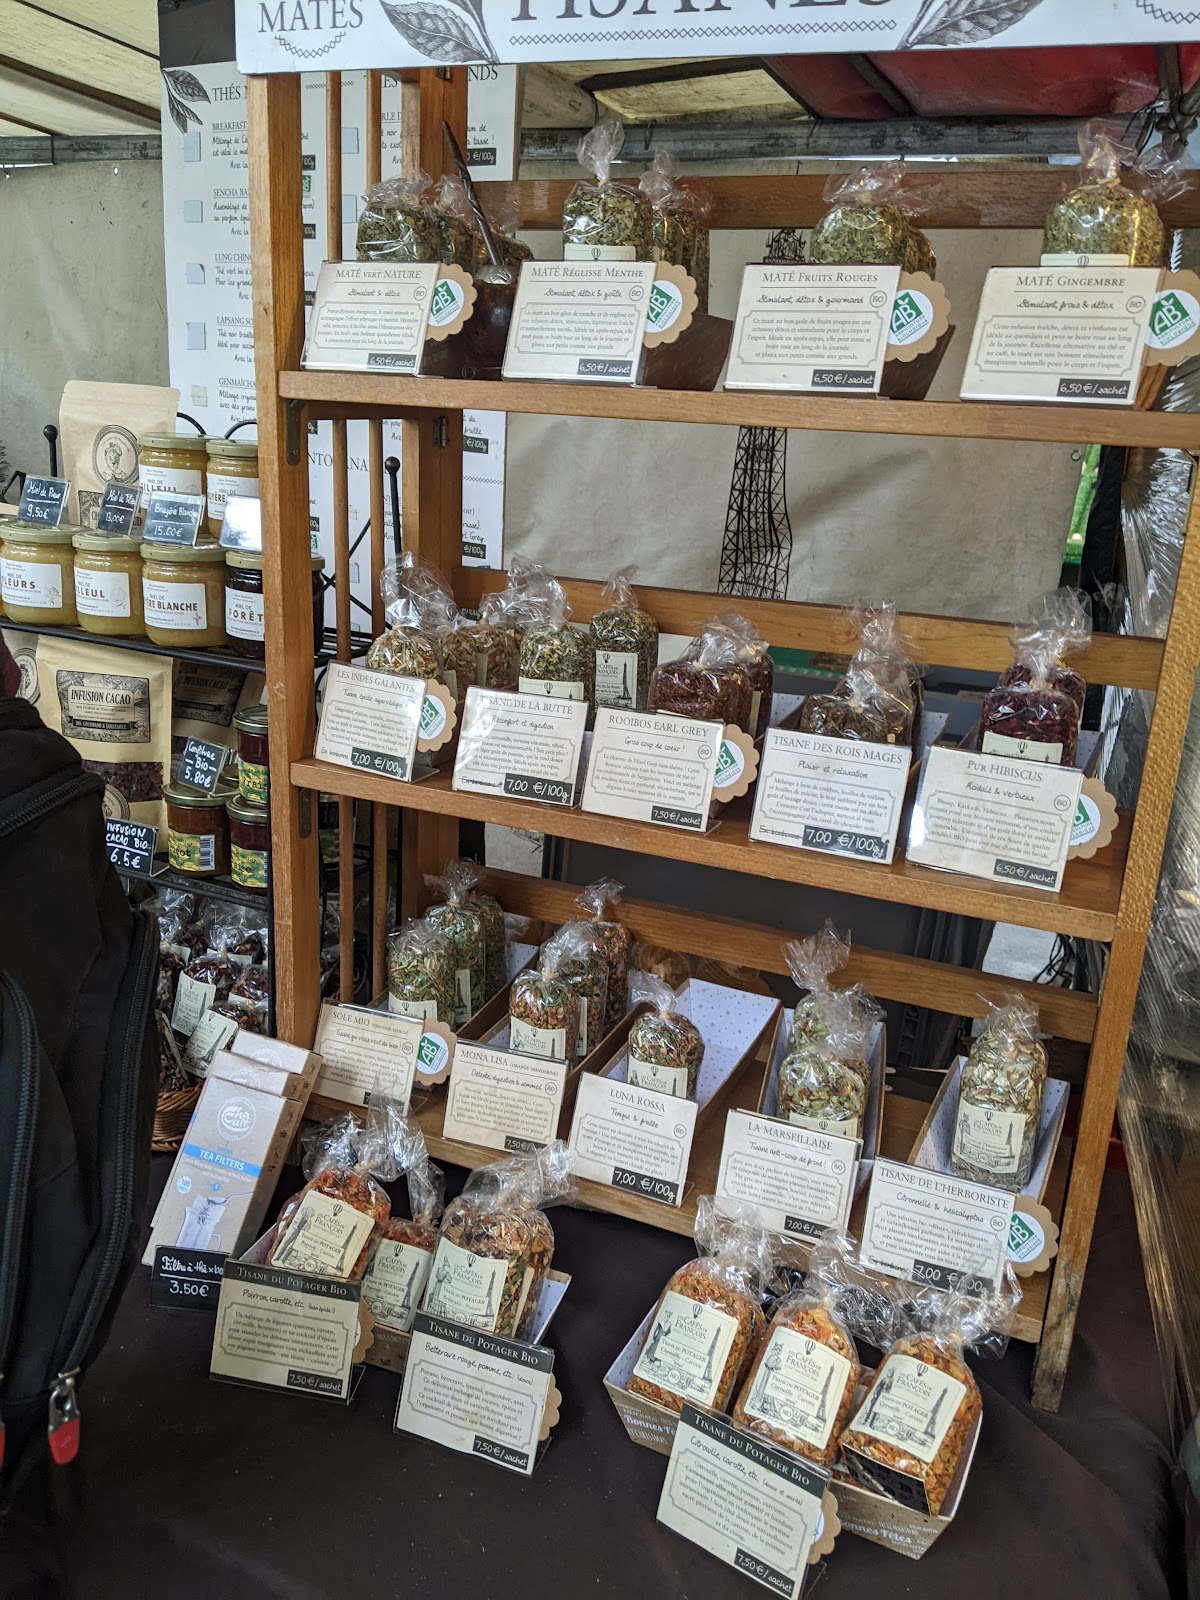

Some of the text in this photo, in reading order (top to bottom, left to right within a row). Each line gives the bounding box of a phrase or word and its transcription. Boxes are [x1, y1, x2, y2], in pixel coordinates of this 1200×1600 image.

[212, 83, 241, 101] THÉS
[212, 121, 247, 131] BREAKFAST
[215, 253, 232, 261] LUNG
[336, 268, 361, 278] MATÉ
[384, 270, 421, 279] NATURE
[531, 266, 643, 278] MATÉ RÉGLISSE MENTHE
[762, 270, 878, 282] MATÉ FRUITS ROUGES
[1016, 274, 1126, 287] MATÉ GINGEMBRE
[826, 296, 864, 307] gourmand
[217, 316, 245, 325] LAPSANG
[891, 303, 917, 331] AB
[1154, 305, 1183, 334] AB
[27, 504, 49, 519] 9.50€
[155, 525, 183, 537] 15.00€
[157, 603, 197, 611] BLANCHE
[337, 670, 415, 692] LES INDES GALANTES
[71, 689, 131, 705] INFUSION CACAO
[513, 700, 573, 715] DE LA BUTTE
[529, 721, 554, 731] digestion
[609, 714, 709, 737] ROOIBOS EARL GREY
[773, 735, 902, 764] TISANE DES ROIS MAGES
[352, 752, 370, 765] 7,00
[185, 766, 211, 788] 5.80€
[833, 768, 868, 779] relaxation
[967, 760, 1043, 782] PUR HIBISCUS
[506, 779, 528, 792] 7,00
[106, 833, 128, 845] CACAO
[806, 829, 832, 844] 7,00
[111, 848, 140, 868] 6.5€
[333, 1012, 370, 1026] SOLE MIO
[461, 1049, 508, 1066] MONA LISA
[610, 1088, 666, 1112] LUNA ROSSA
[748, 1122, 833, 1151] LA MARSEILLAISE
[200, 1149, 214, 1161] TEA
[215, 1155, 245, 1171] FILTERS
[615, 1171, 636, 1186] 7,00
[880, 1167, 1009, 1209] TISANE DE L'HERBORISTE
[170, 1280, 209, 1297] 3.50€
[237, 1267, 347, 1295] TISANE DU POTAGER BIO
[675, 1319, 706, 1339] FRANÇOIS
[429, 1321, 538, 1365] TISANE DU POTAGER BIO
[682, 1347, 706, 1363] POTAGER
[786, 1355, 820, 1377] FRANÇOIS
[794, 1384, 820, 1400] POTAGER
[694, 1413, 726, 1440] TISANE
[729, 1436, 743, 1449] DU
[745, 1441, 789, 1475] POTAGER
[791, 1467, 810, 1486] BIO
